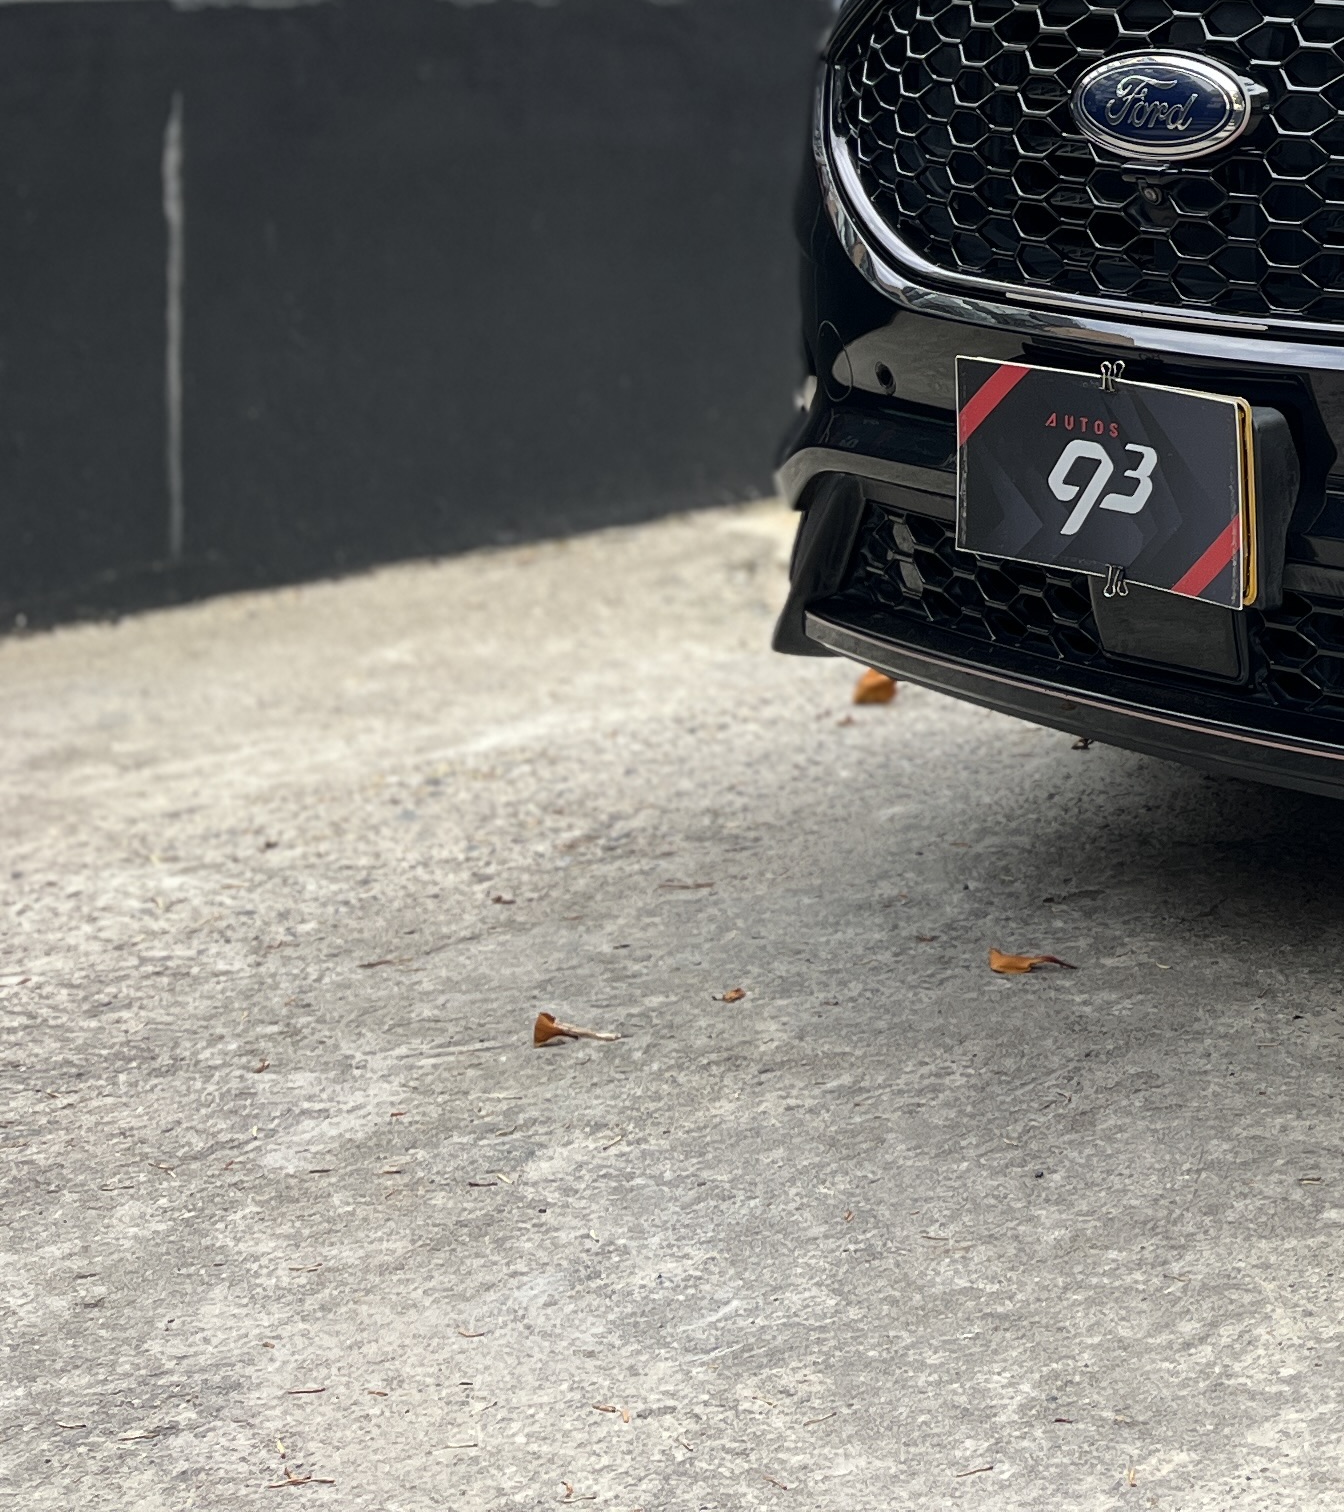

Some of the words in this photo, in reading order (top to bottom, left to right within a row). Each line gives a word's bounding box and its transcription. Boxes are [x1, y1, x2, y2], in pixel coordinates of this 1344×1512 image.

[1106, 75, 1198, 130] Ford
[1045, 412, 1119, 438] AUTOS
[1047, 439, 1158, 536] 93
